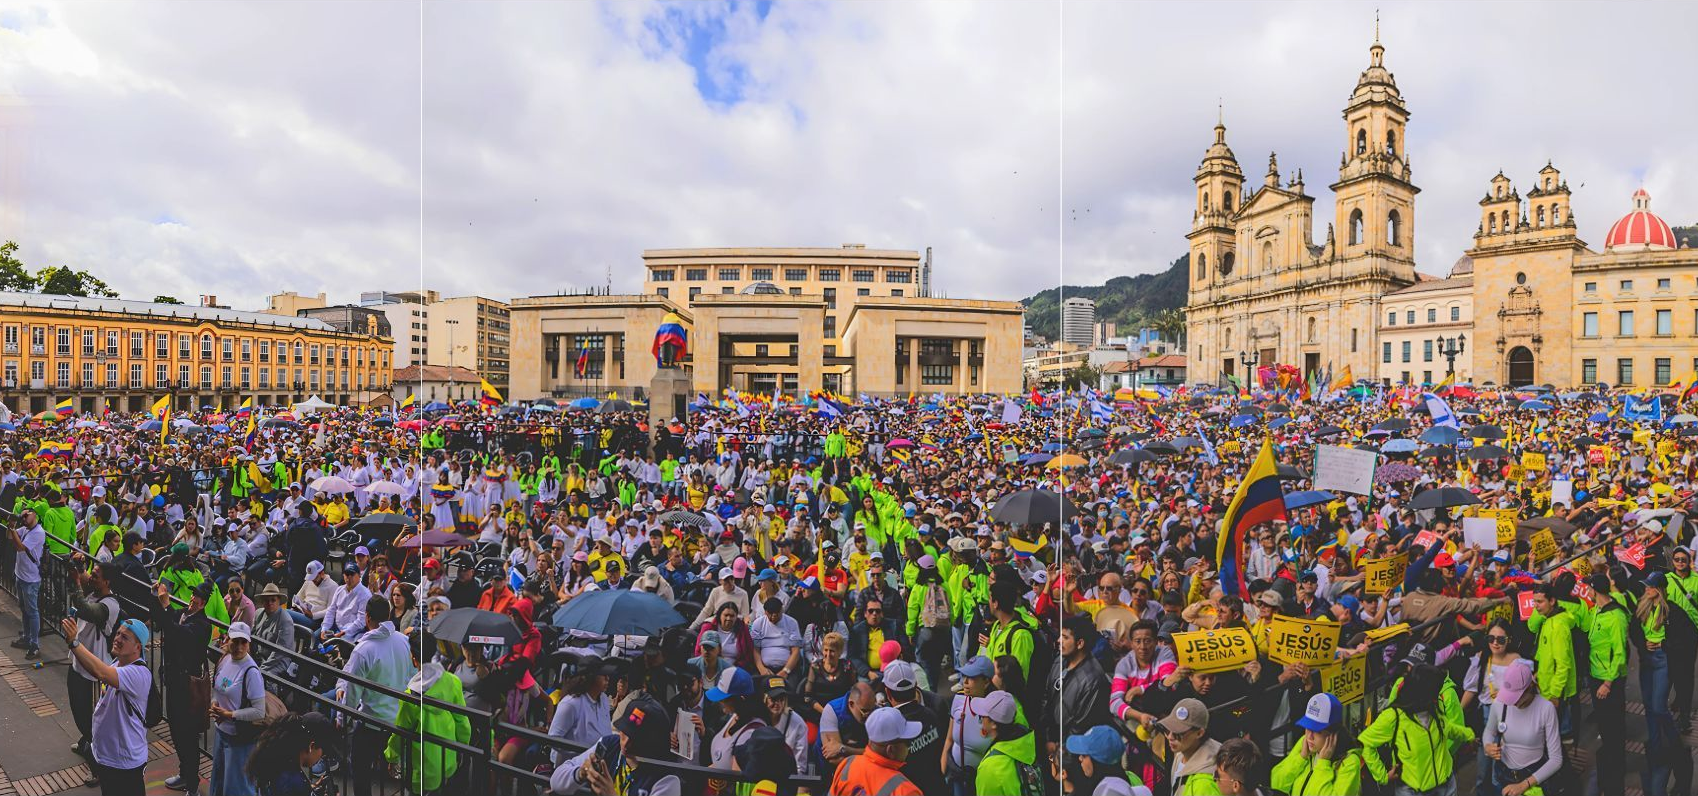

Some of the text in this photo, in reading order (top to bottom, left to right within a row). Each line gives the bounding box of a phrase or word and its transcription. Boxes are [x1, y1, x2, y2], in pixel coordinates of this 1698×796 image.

[1185, 634, 1245, 653] JESÚS
[1276, 632, 1333, 651] JESÚS
[1200, 651, 1236, 662] REINA
[1286, 649, 1319, 660] REINA
[1327, 668, 1361, 693] JESÚS
[1335, 685, 1353, 697] REINA
